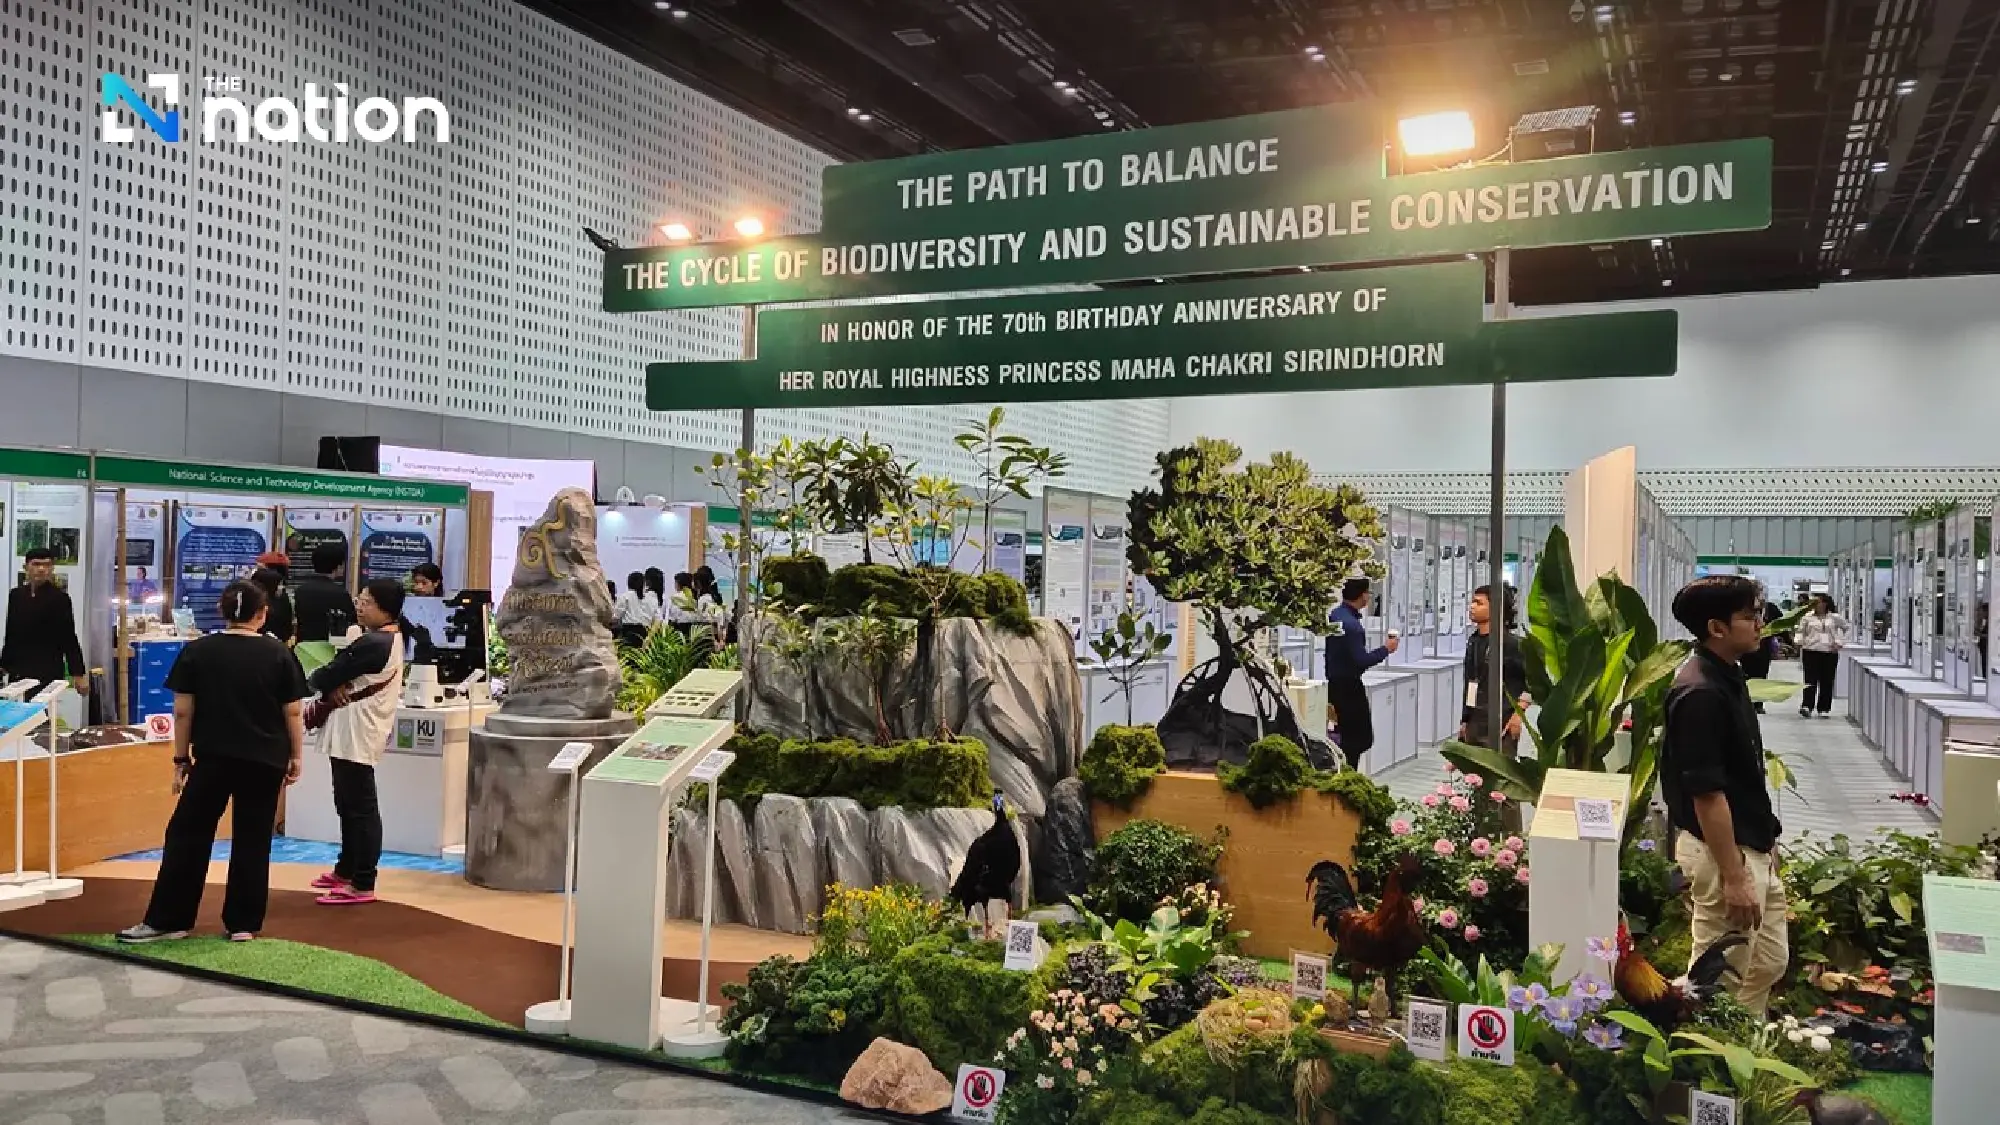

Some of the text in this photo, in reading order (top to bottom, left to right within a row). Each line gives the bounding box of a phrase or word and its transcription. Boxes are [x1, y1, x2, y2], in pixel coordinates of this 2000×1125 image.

[897, 139, 1278, 209] THE PATH TO BALANCE
[623, 162, 1732, 289] THE CYCLE OF BIODIVERSITY AND SUSTAINABLE CONSERVATION
[822, 288, 1386, 343] IN HONOR OF THE 70th BIRTHDAY ANNIVERSARY OF
[780, 343, 1443, 390] HER ROYAL HIGHNESS PRINCESS MAHA CHAKRI SIRINDHORN
[168, 468, 207, 480] National
[210, 471, 244, 484] Science
[245, 476, 262, 486] and
[265, 476, 311, 491] Technology
[313, 480, 366, 493] Development
[368, 485, 393, 497] Agency
[417, 719, 436, 737] KU
